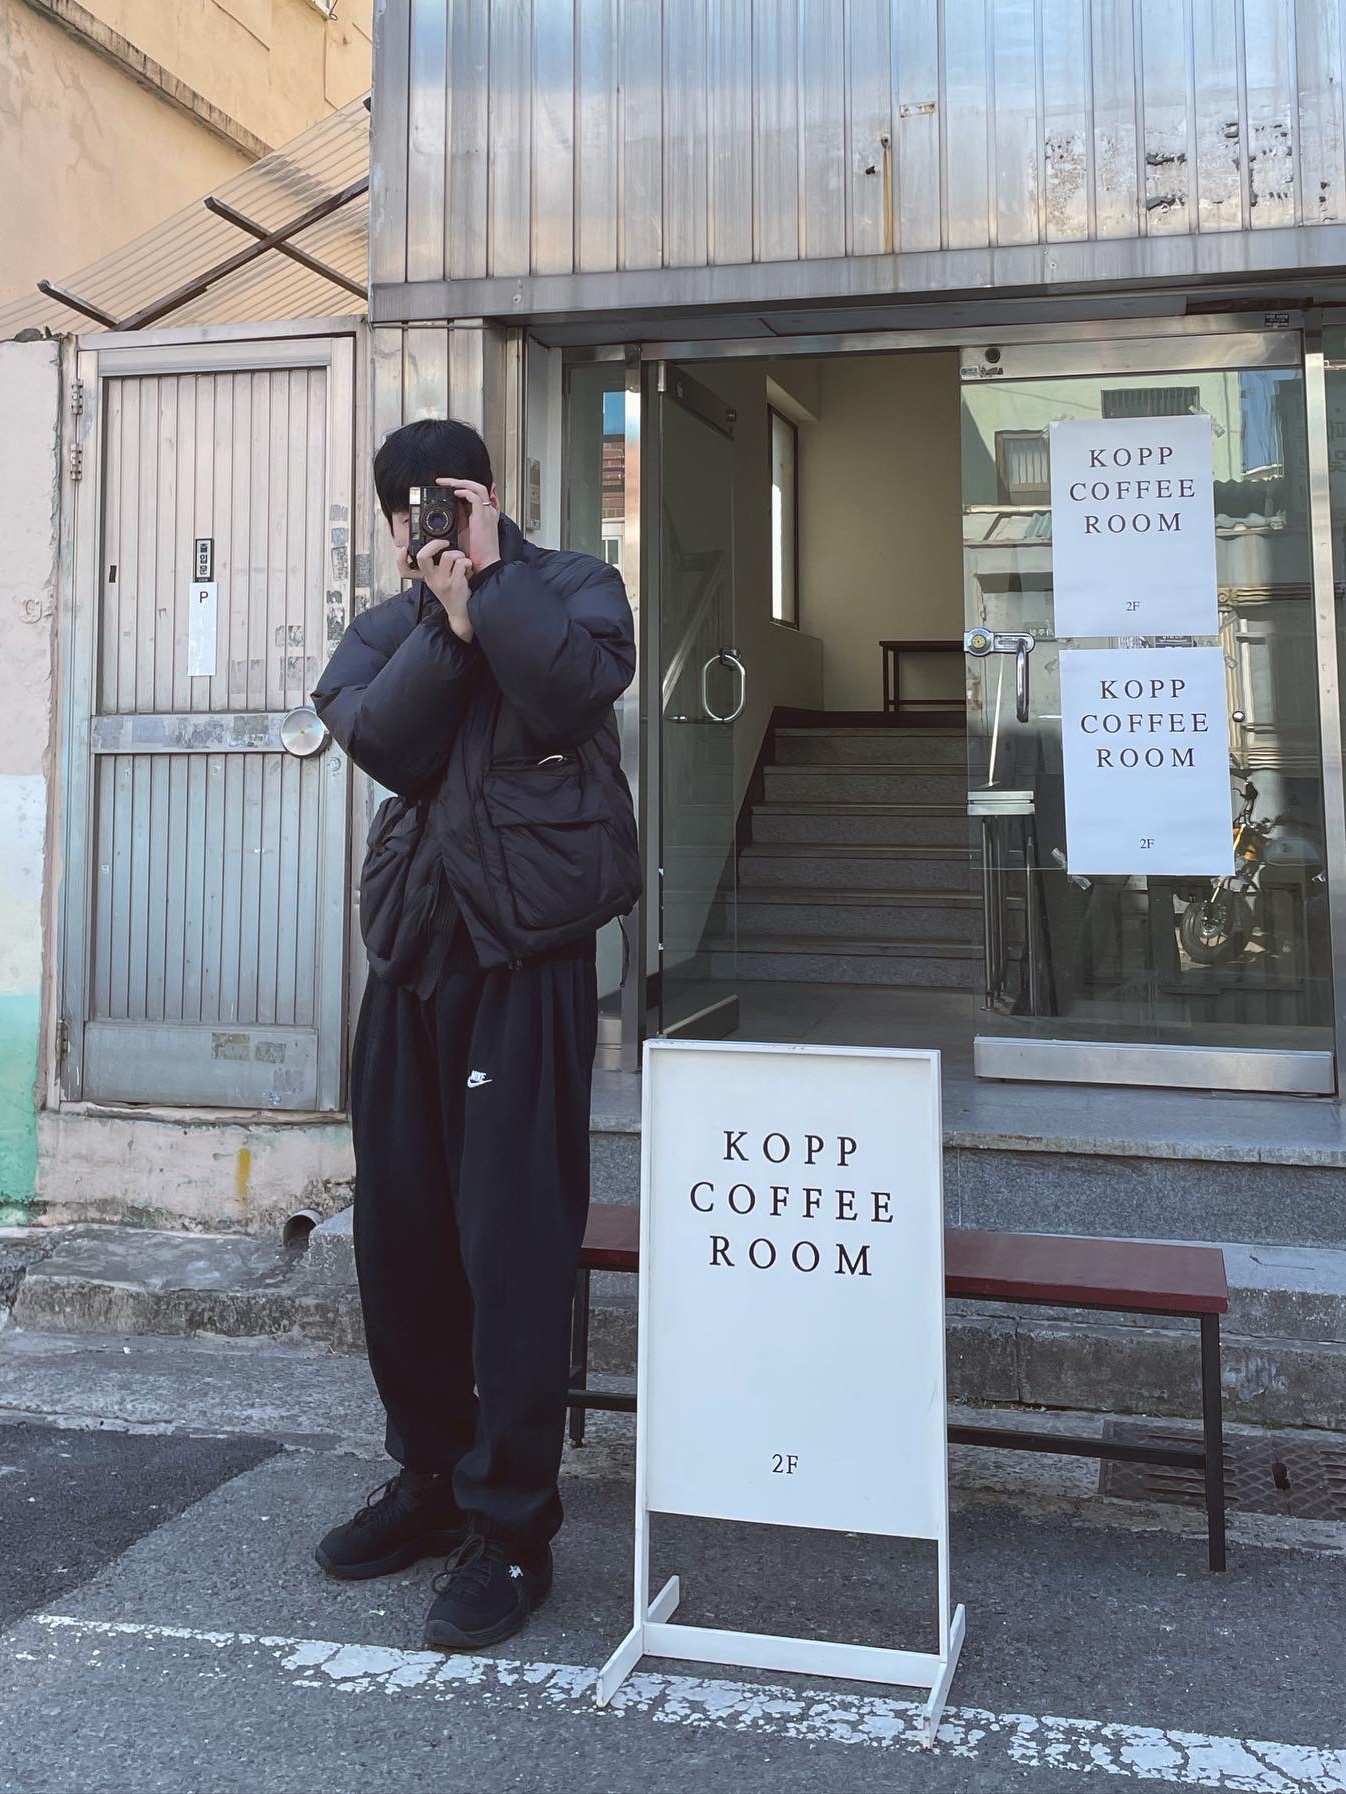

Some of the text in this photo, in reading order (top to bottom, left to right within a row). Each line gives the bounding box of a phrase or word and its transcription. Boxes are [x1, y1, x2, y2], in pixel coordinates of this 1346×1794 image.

[1089, 446, 1174, 468] KOPP
[1069, 479, 1195, 502] COFFEE
[1084, 512, 1181, 534] ROOM
[199, 543, 208, 575] 출입문
[199, 591, 208, 603] P
[1125, 601, 1141, 612] 2F
[1100, 679, 1186, 700] KOPP
[1080, 713, 1209, 734] COFFEE
[1097, 747, 1194, 768] ROOM
[1140, 838, 1155, 849] 2F
[723, 1130, 857, 1167] KOPP
[690, 1181, 894, 1223] COFFEE
[709, 1235, 872, 1276] ROOM
[772, 1453, 799, 1475] 2F
